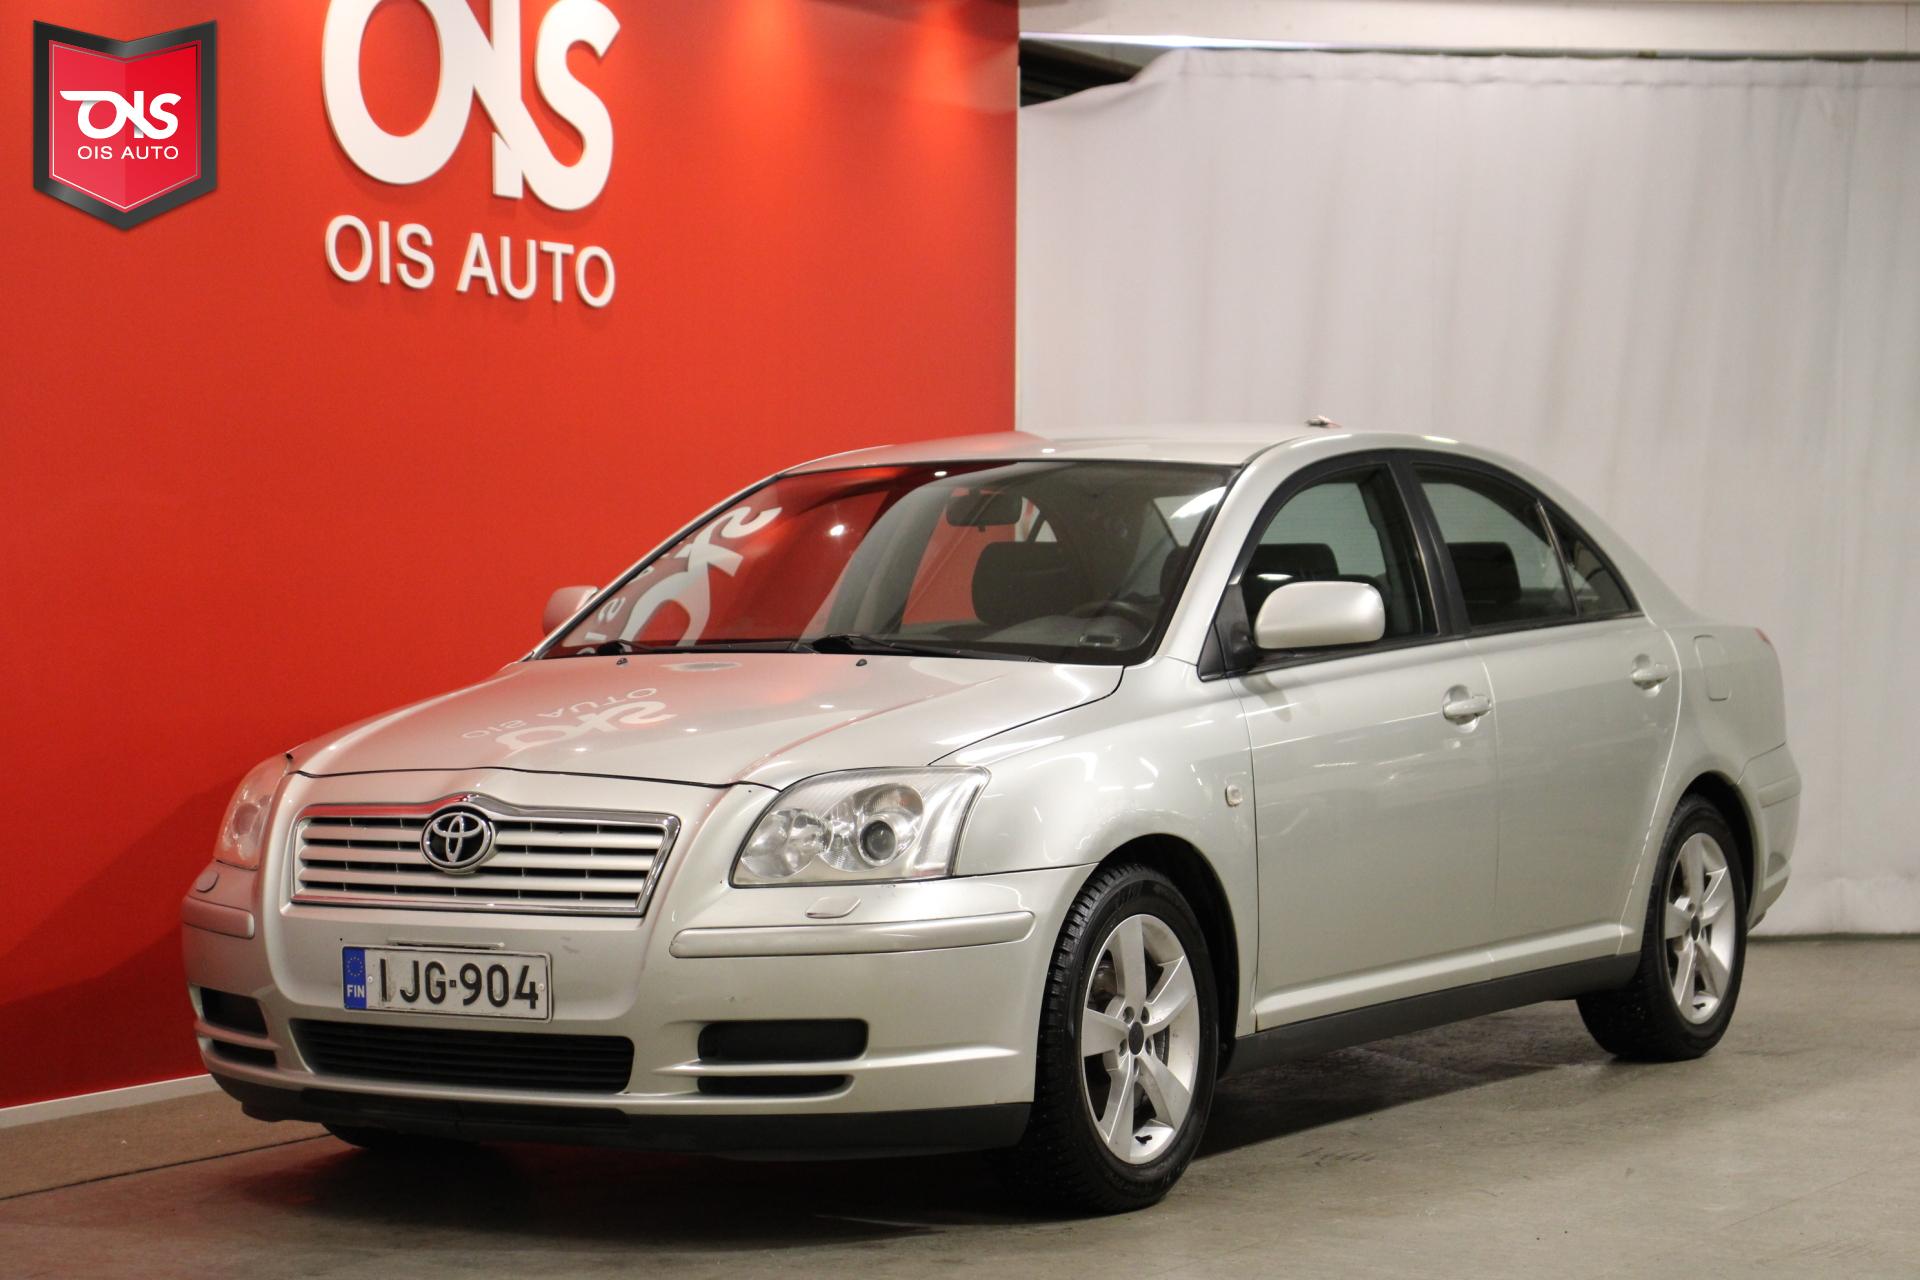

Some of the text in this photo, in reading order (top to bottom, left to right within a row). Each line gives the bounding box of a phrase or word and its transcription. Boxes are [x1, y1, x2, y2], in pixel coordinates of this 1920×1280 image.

[325, 214, 616, 308] OIS AUTO
[347, 984, 365, 999] FIN
